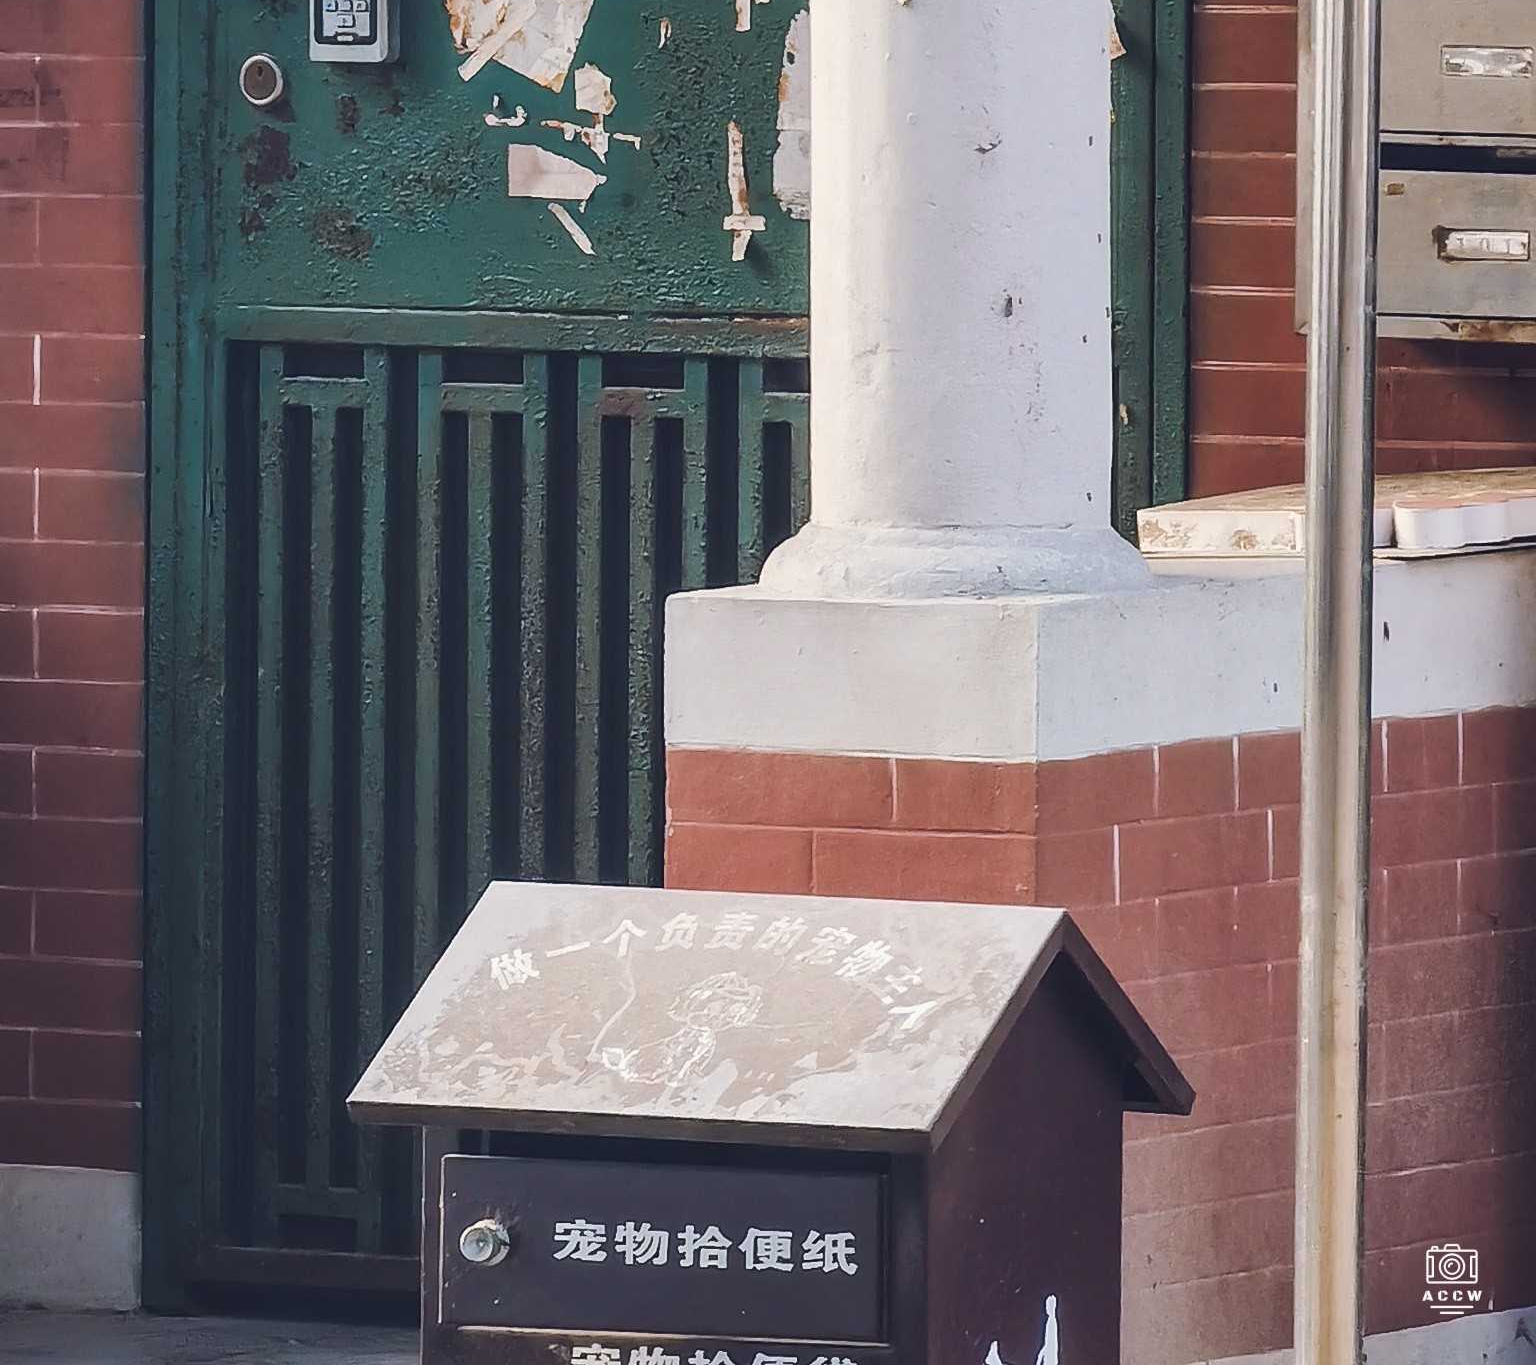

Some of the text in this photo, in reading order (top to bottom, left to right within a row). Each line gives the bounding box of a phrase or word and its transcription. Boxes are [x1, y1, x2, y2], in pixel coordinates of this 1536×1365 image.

[552, 1219, 859, 1275] 宠物拾便纸
